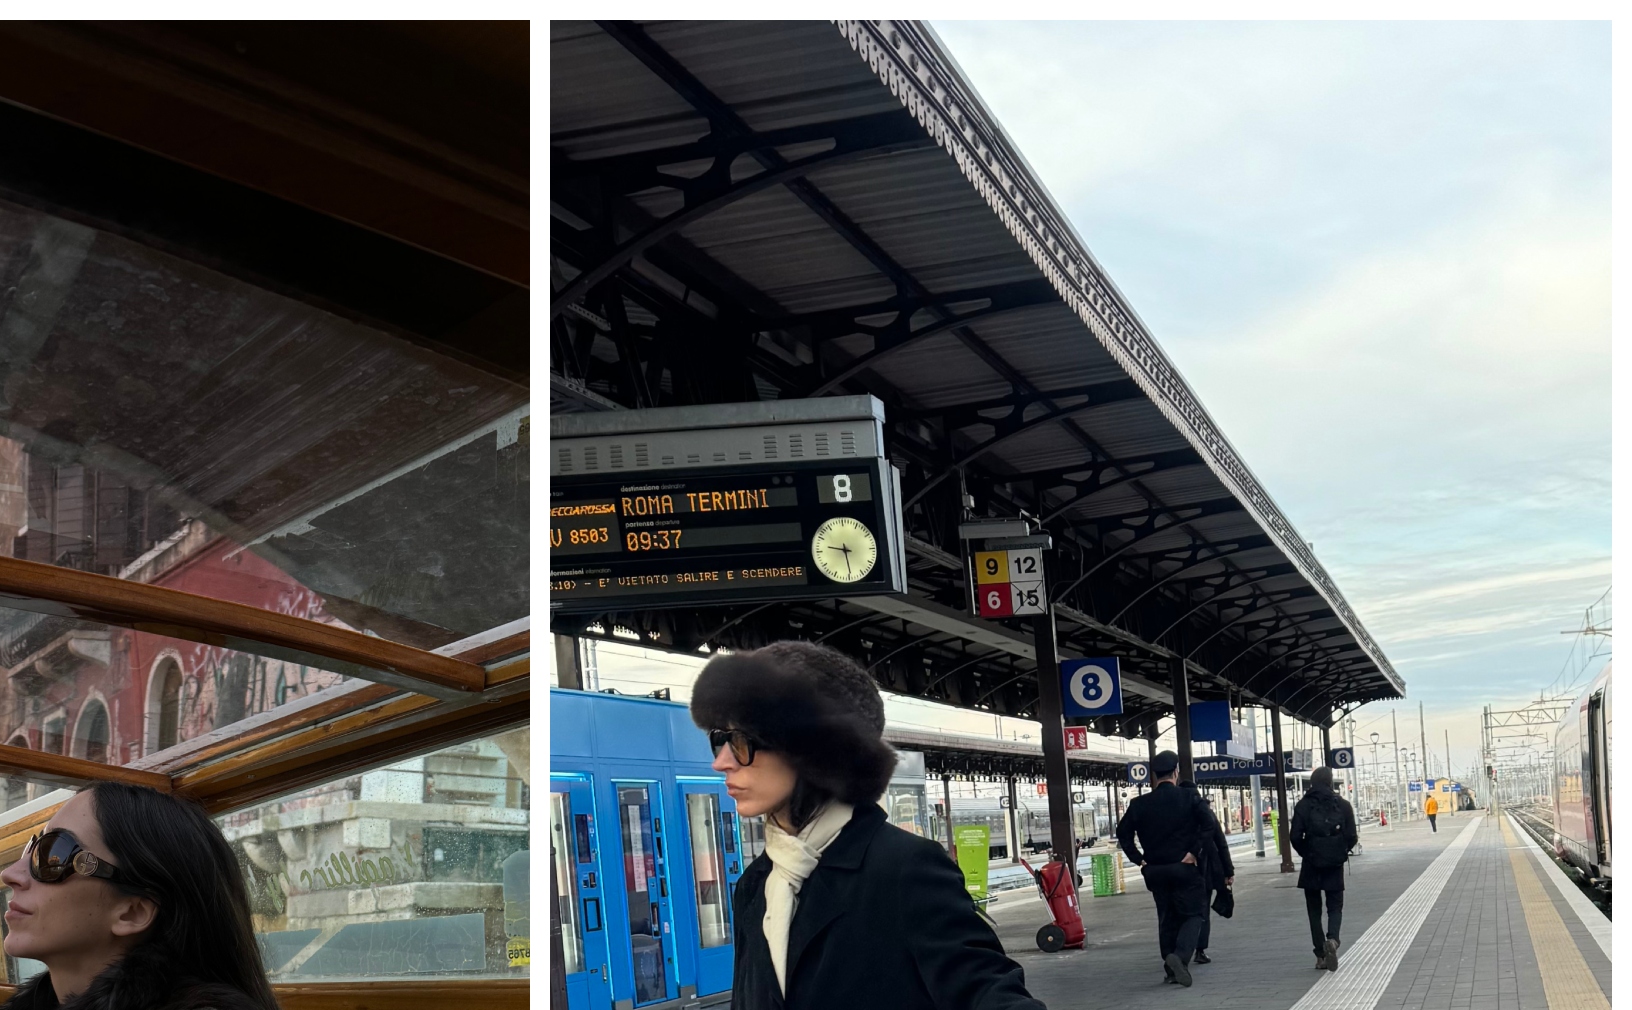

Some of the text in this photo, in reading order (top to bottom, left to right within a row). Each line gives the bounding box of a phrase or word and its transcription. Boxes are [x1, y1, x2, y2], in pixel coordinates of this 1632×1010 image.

[620, 484, 660, 493] destinazione
[832, 474, 853, 502] 8
[621, 488, 770, 517] ROMA TERMINI
[625, 520, 655, 529] partenza
[570, 527, 609, 544] 8503
[626, 529, 682, 551] 09:37
[985, 557, 999, 575] 9
[1014, 556, 1037, 574] 12
[618, 573, 669, 586] VIETATO
[676, 571, 719, 583] SALIRE
[727, 570, 734, 580] E
[741, 566, 803, 579] SCENDERE
[986, 590, 1001, 609] 6
[1016, 589, 1040, 606] 15
[1081, 672, 1103, 701] 8
[1233, 757, 1264, 769] Porta
[1340, 752, 1347, 763] 8
[1132, 767, 1146, 777] 10
